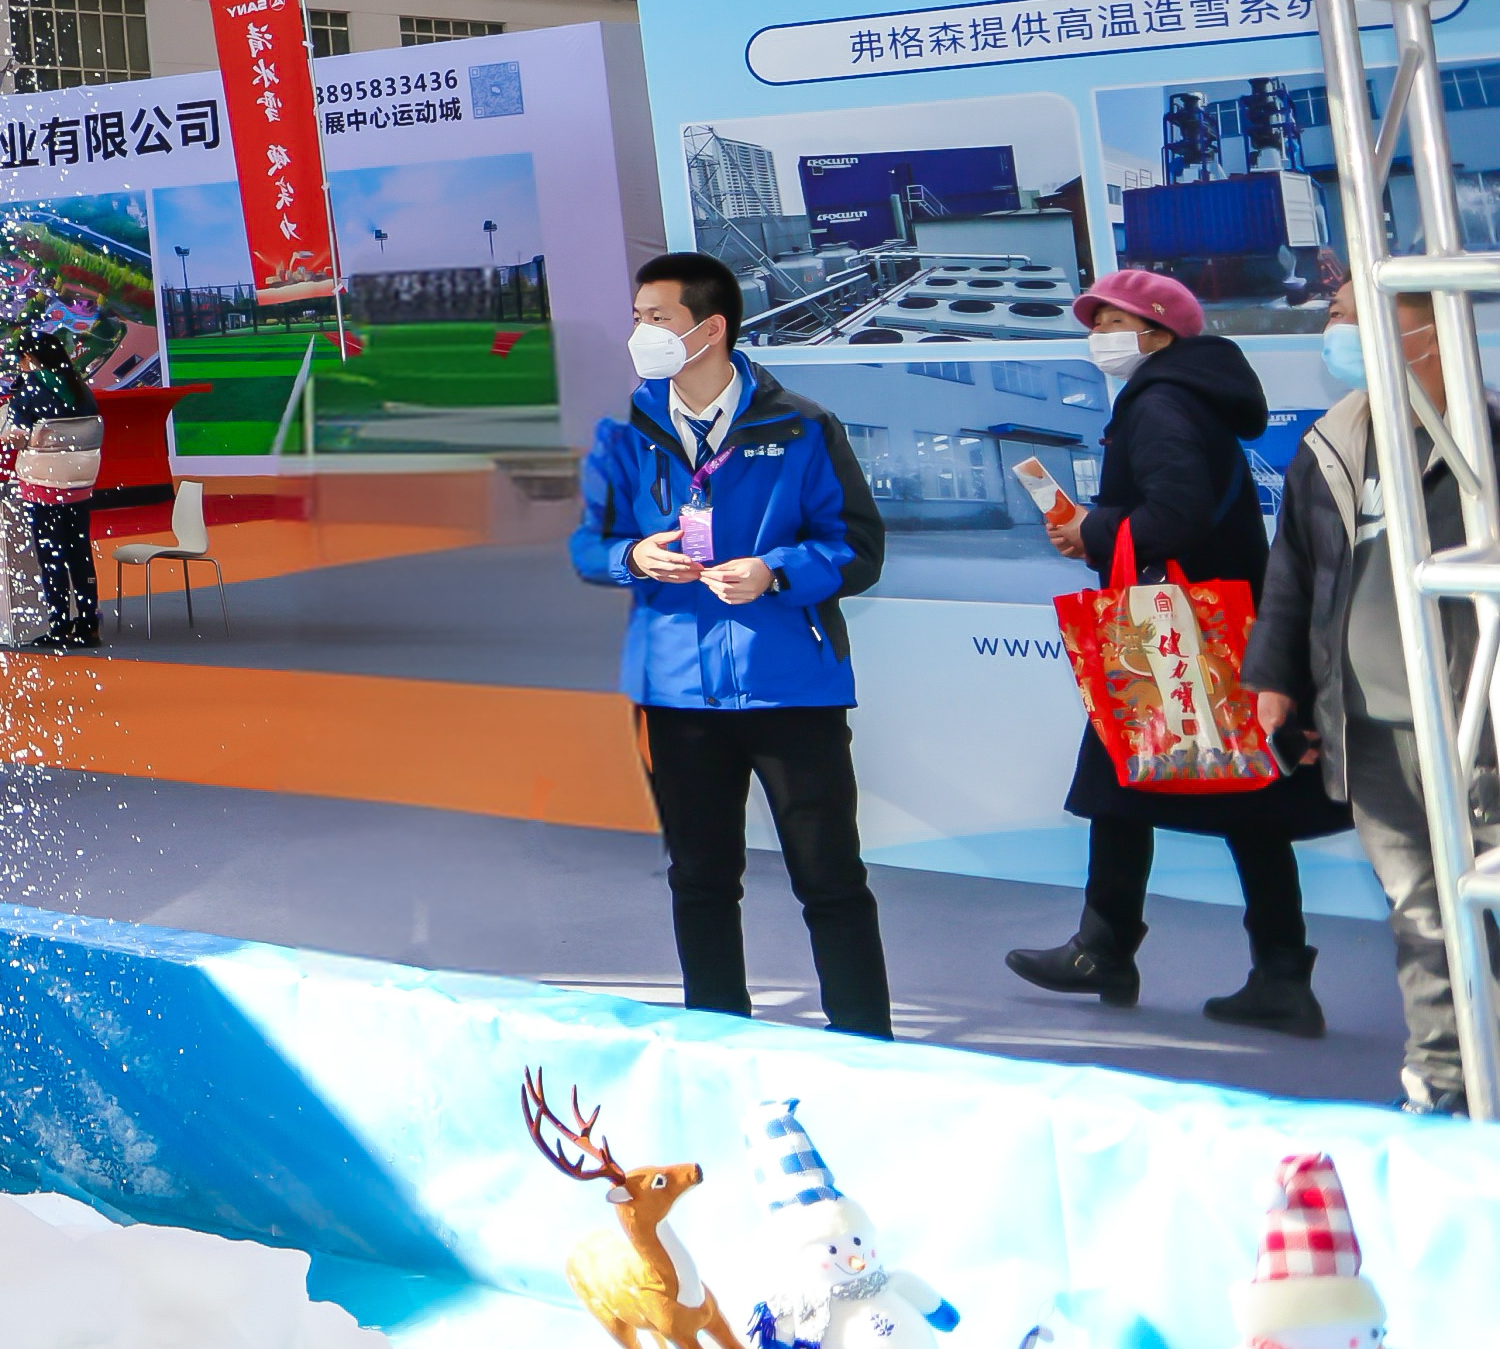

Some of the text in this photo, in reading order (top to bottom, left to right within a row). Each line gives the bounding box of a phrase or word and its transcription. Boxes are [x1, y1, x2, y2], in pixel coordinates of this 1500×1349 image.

[320, 97, 463, 134] 展中心运动城
